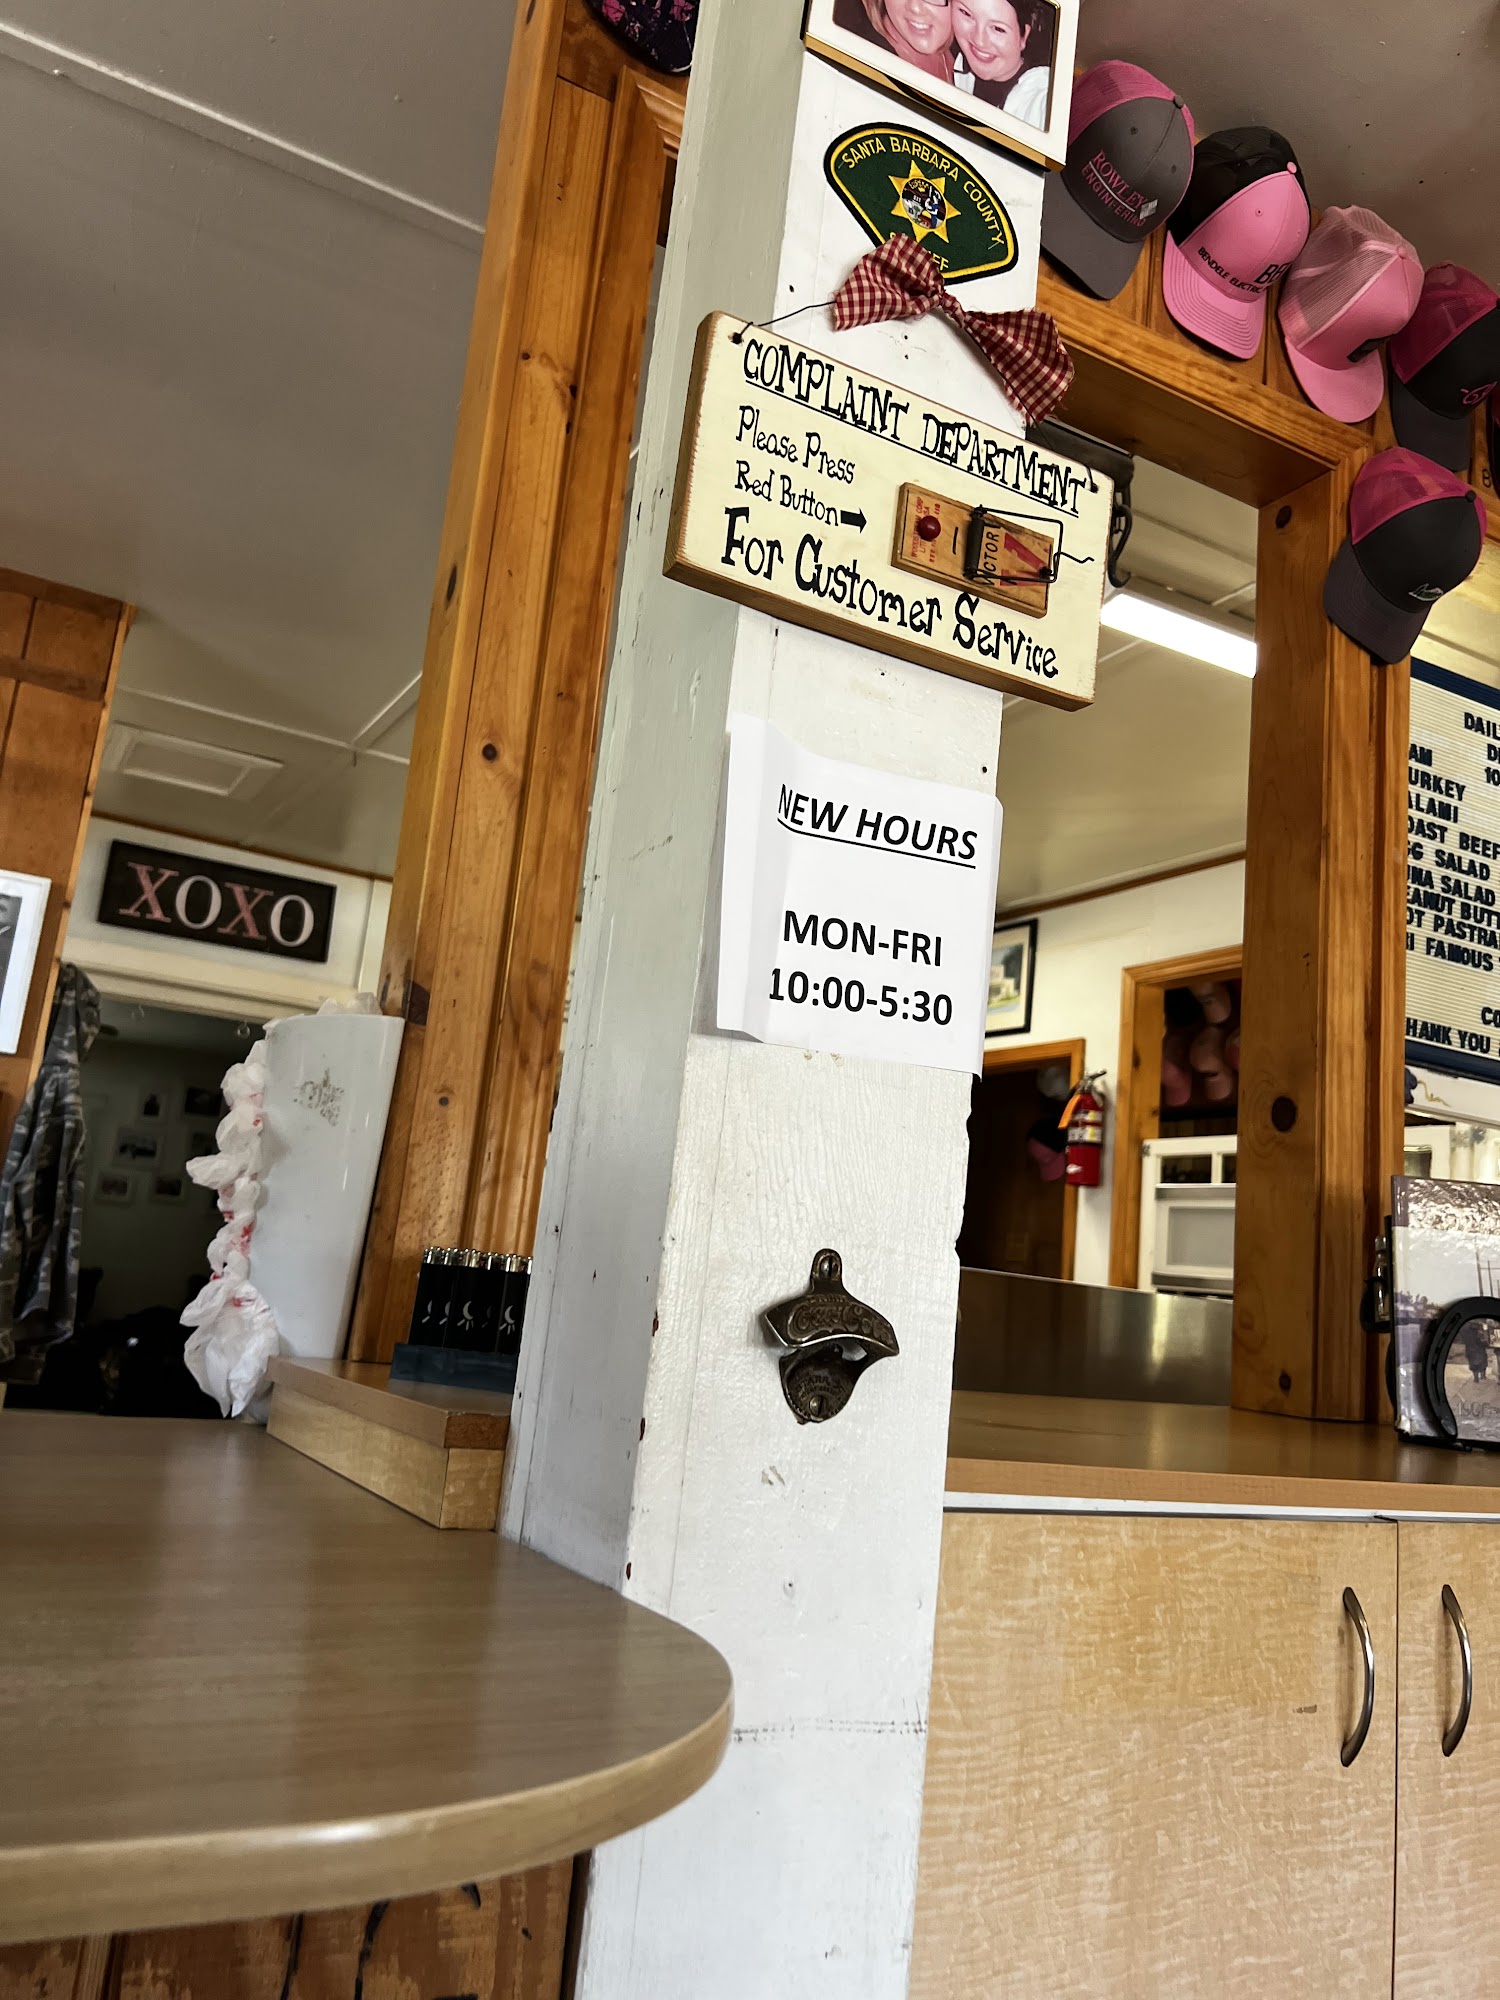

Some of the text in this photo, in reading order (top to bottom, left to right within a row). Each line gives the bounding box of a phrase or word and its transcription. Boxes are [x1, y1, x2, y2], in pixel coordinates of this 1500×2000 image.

[841, 136, 1005, 246] SANTA BARBARA COUNTY
[1093, 150, 1148, 209] ROWLEY
[1197, 246, 1230, 279] BENDELE
[736, 405, 855, 484] Please Press
[743, 338, 1086, 511] COMPLAINT DEPARTMENT
[735, 459, 839, 527] Red Button
[721, 507, 784, 580] For
[795, 533, 942, 637] Customer
[952, 592, 1058, 679] Service
[1464, 711, 1500, 741] DAIL
[778, 784, 977, 860] NEW HOURS
[1459, 831, 1500, 860] BEEF
[1435, 849, 1490, 880] SALAD
[1441, 875, 1496, 907] SALAD
[119, 861, 315, 948] XOXO
[1434, 914, 1500, 949] PASTRA
[784, 910, 942, 967] MON-FRI
[1426, 937, 1493, 972] FAMOUS
[769, 967, 952, 1026] 10:00-5:30
[1458, 1029, 1491, 1053] YOU
